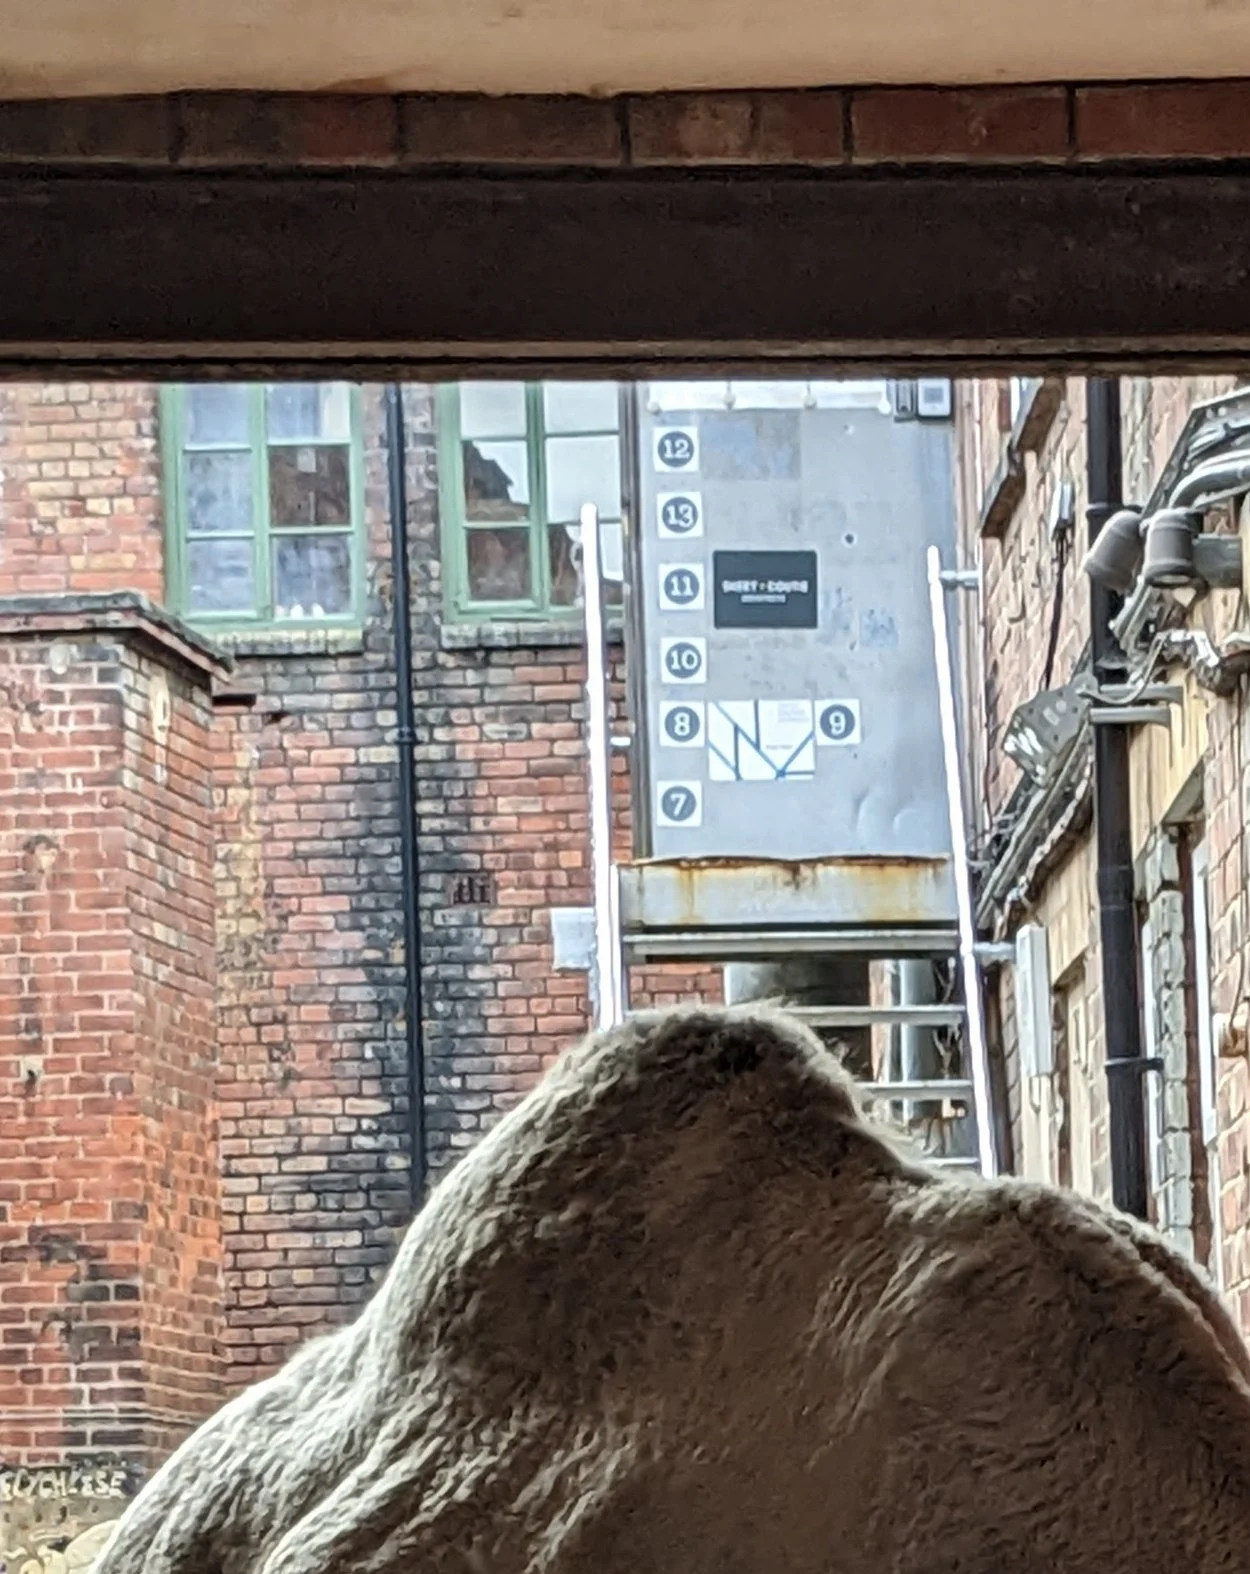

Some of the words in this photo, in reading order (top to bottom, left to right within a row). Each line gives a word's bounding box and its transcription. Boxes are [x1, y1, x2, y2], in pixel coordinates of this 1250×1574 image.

[662, 438, 690, 460] 12
[666, 503, 697, 528] 13
[669, 574, 694, 597] 11
[670, 648, 699, 671] 10
[674, 711, 691, 737] 8
[828, 711, 846, 736] 9
[670, 792, 687, 817] 7
